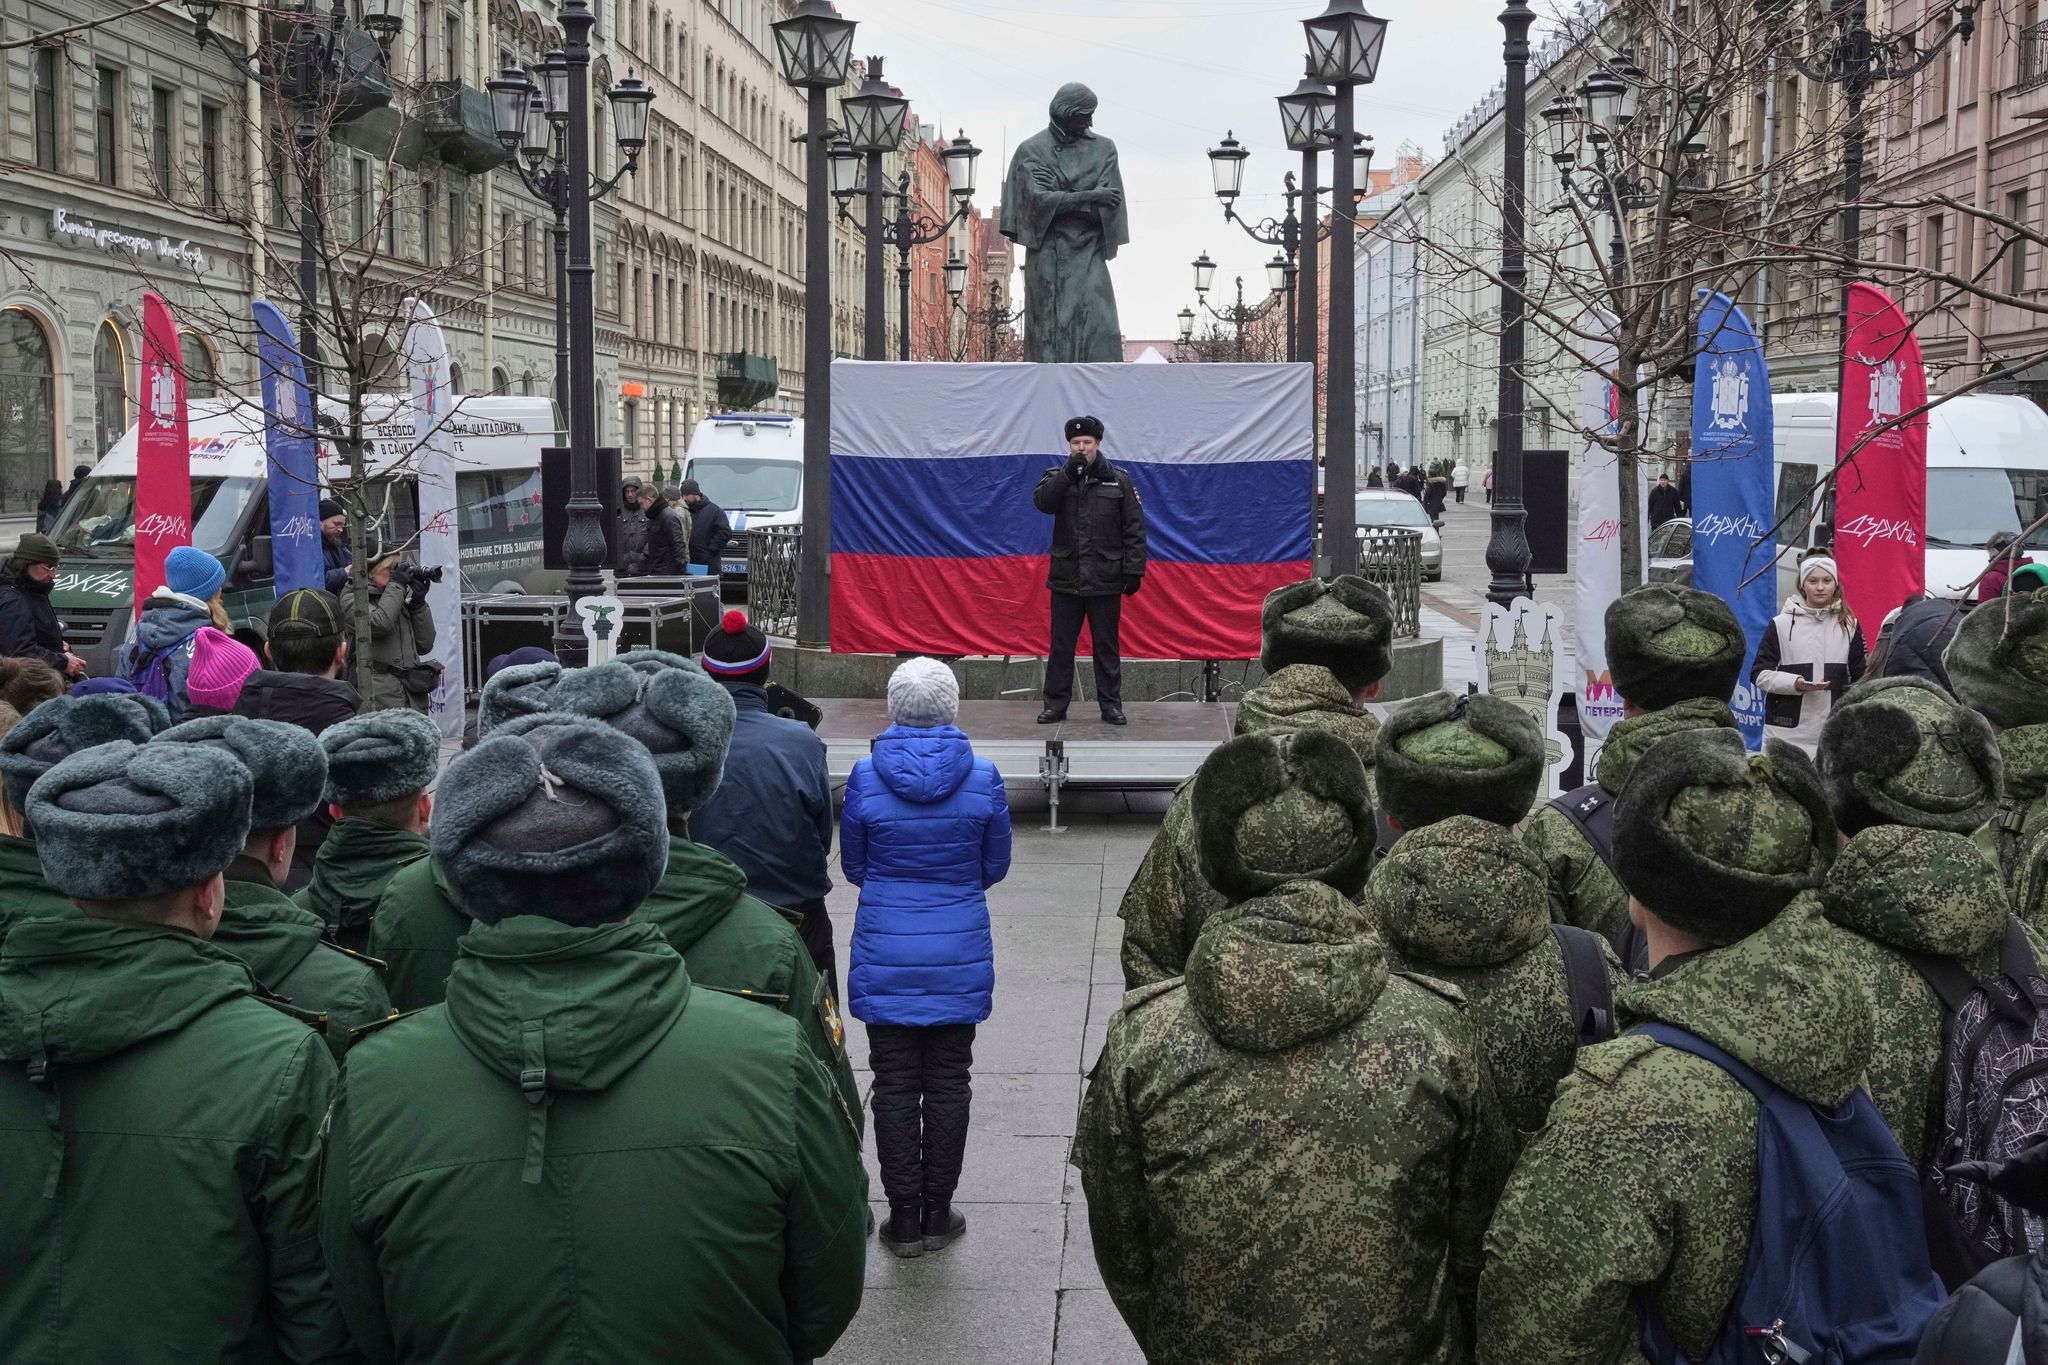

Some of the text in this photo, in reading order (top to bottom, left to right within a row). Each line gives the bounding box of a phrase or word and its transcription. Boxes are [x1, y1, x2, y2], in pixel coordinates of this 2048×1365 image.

[54, 208, 152, 254] Винный ресторан
[493, 543, 514, 555] СУДЕБ
[1585, 705, 1624, 717] ПЕТЕРБ
